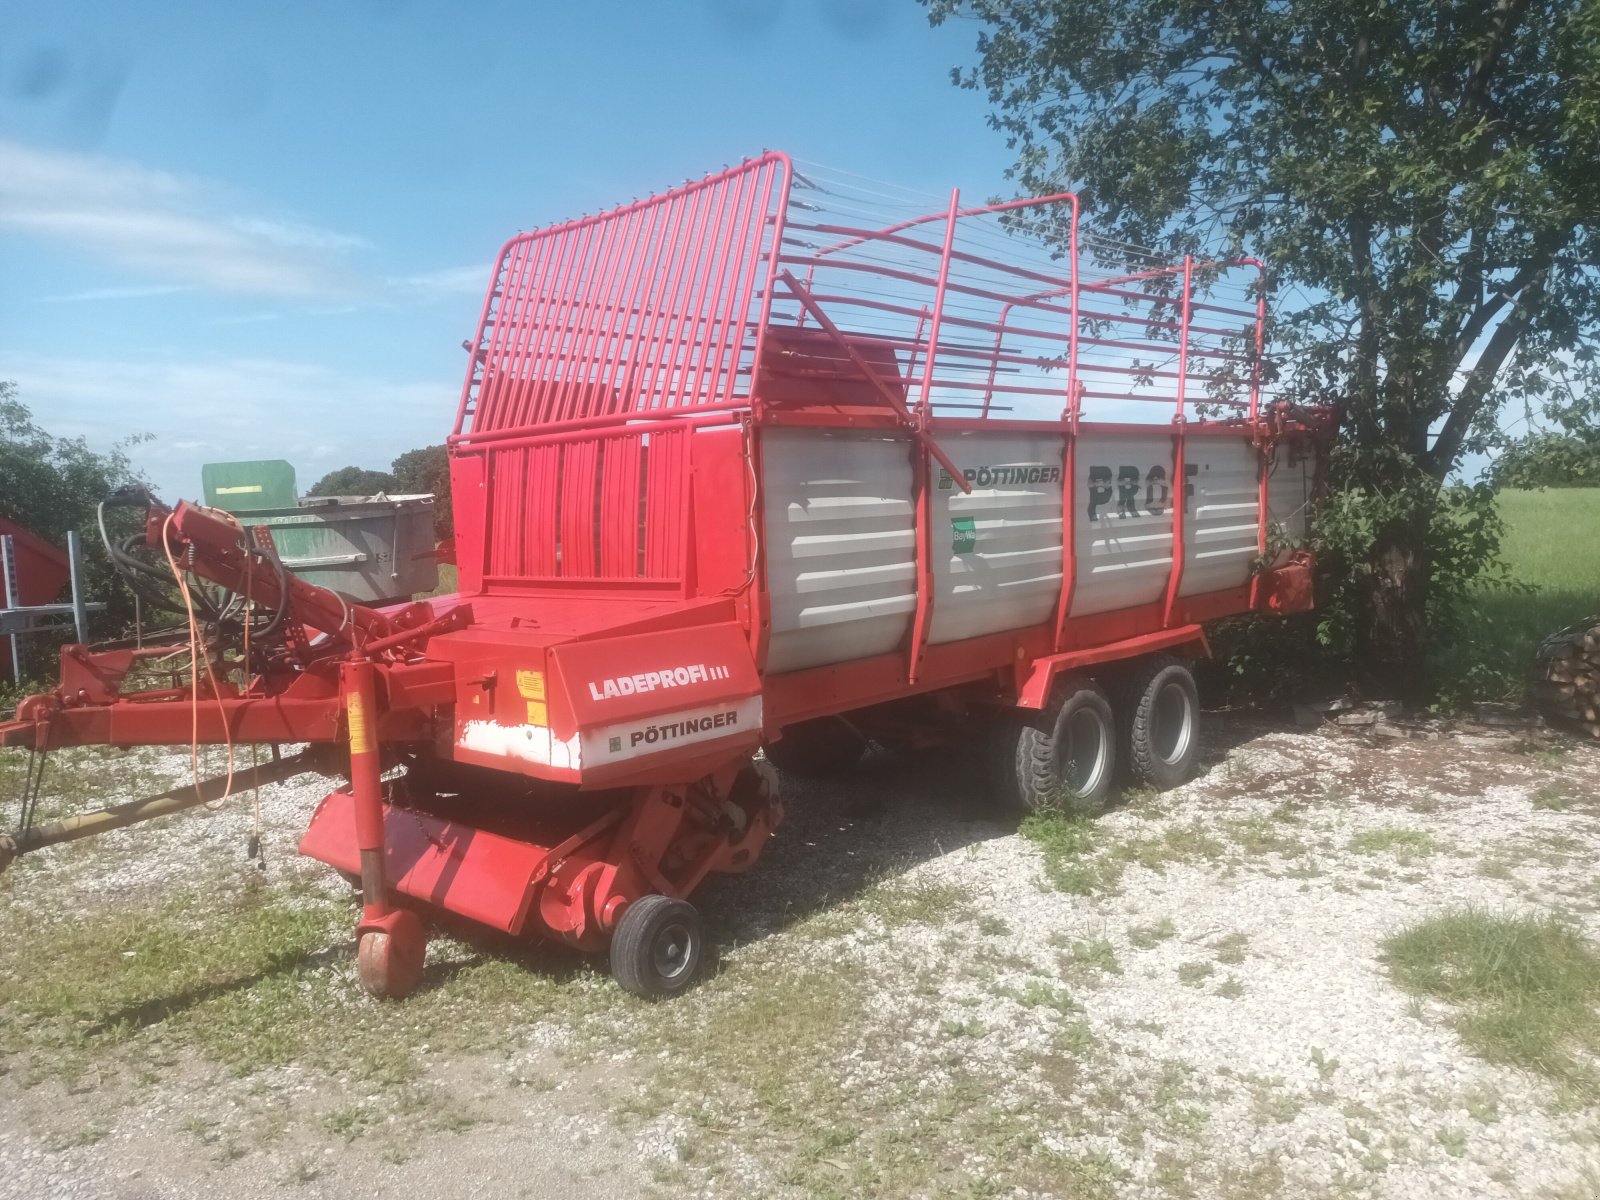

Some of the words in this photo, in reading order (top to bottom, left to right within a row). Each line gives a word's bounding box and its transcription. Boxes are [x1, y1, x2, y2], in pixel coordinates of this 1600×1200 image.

[963, 466, 1060, 487] PÖTTINGER
[589, 664, 708, 701] LADEPROFI
[630, 711, 737, 747] PÖTTINGER
